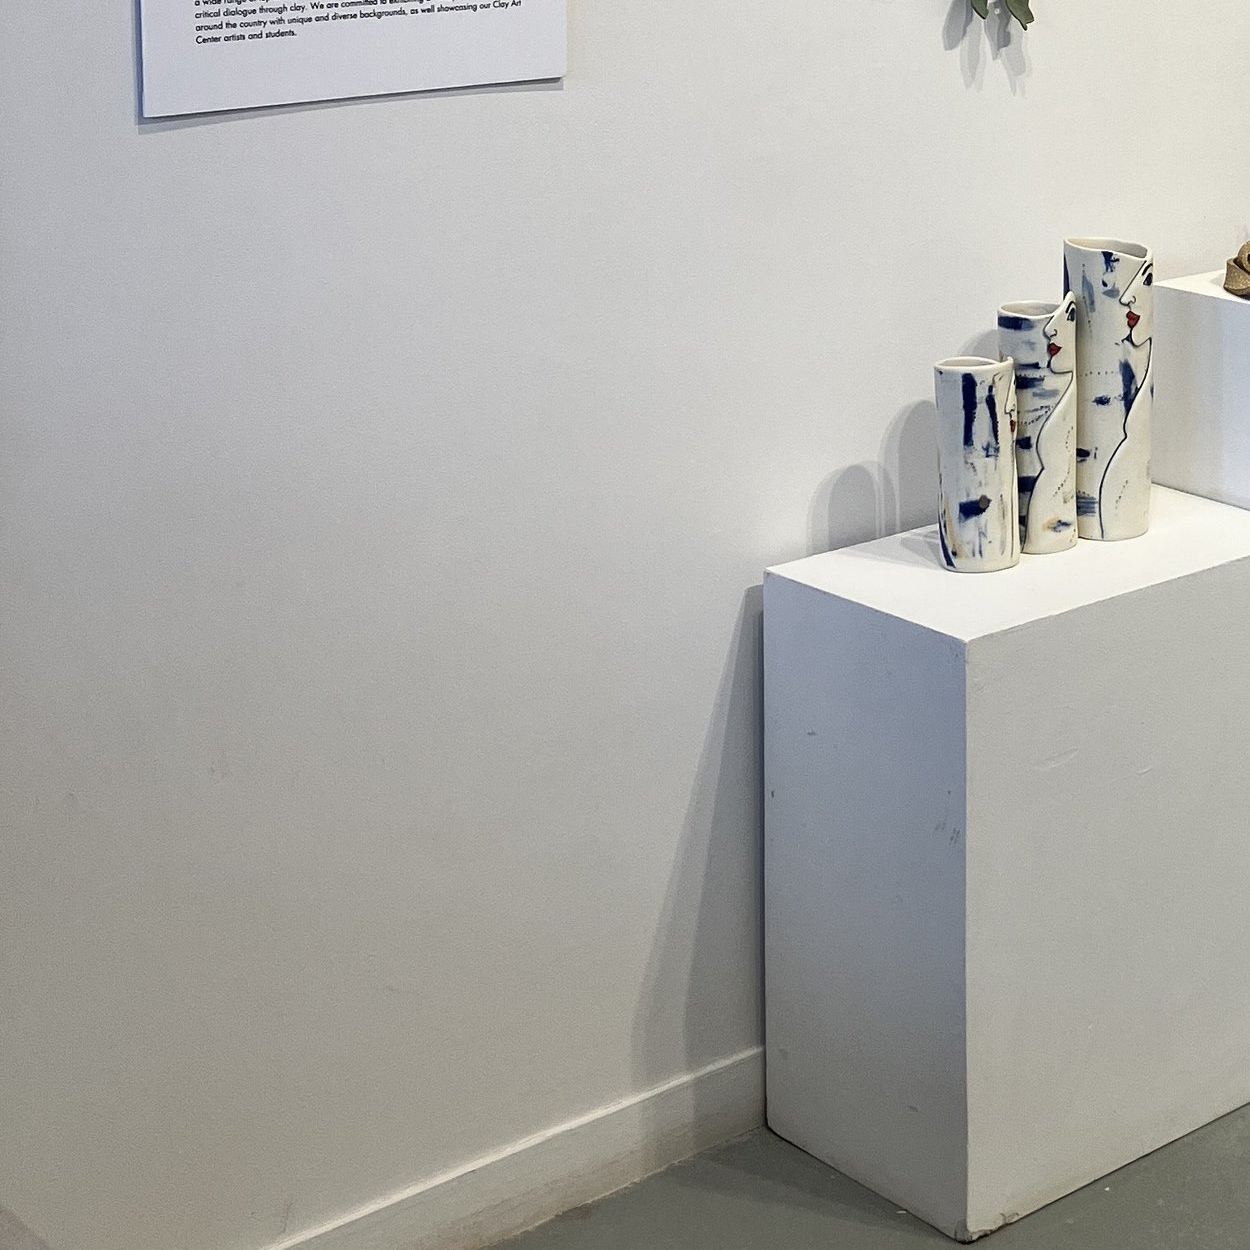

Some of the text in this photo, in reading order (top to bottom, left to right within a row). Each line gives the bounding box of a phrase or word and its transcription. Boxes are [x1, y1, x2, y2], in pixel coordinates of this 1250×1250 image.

[195, 0, 521, 32] around country with unique diverse backgrounds, showcasing Clay Art
[195, 29, 297, 44] Center artists students.
